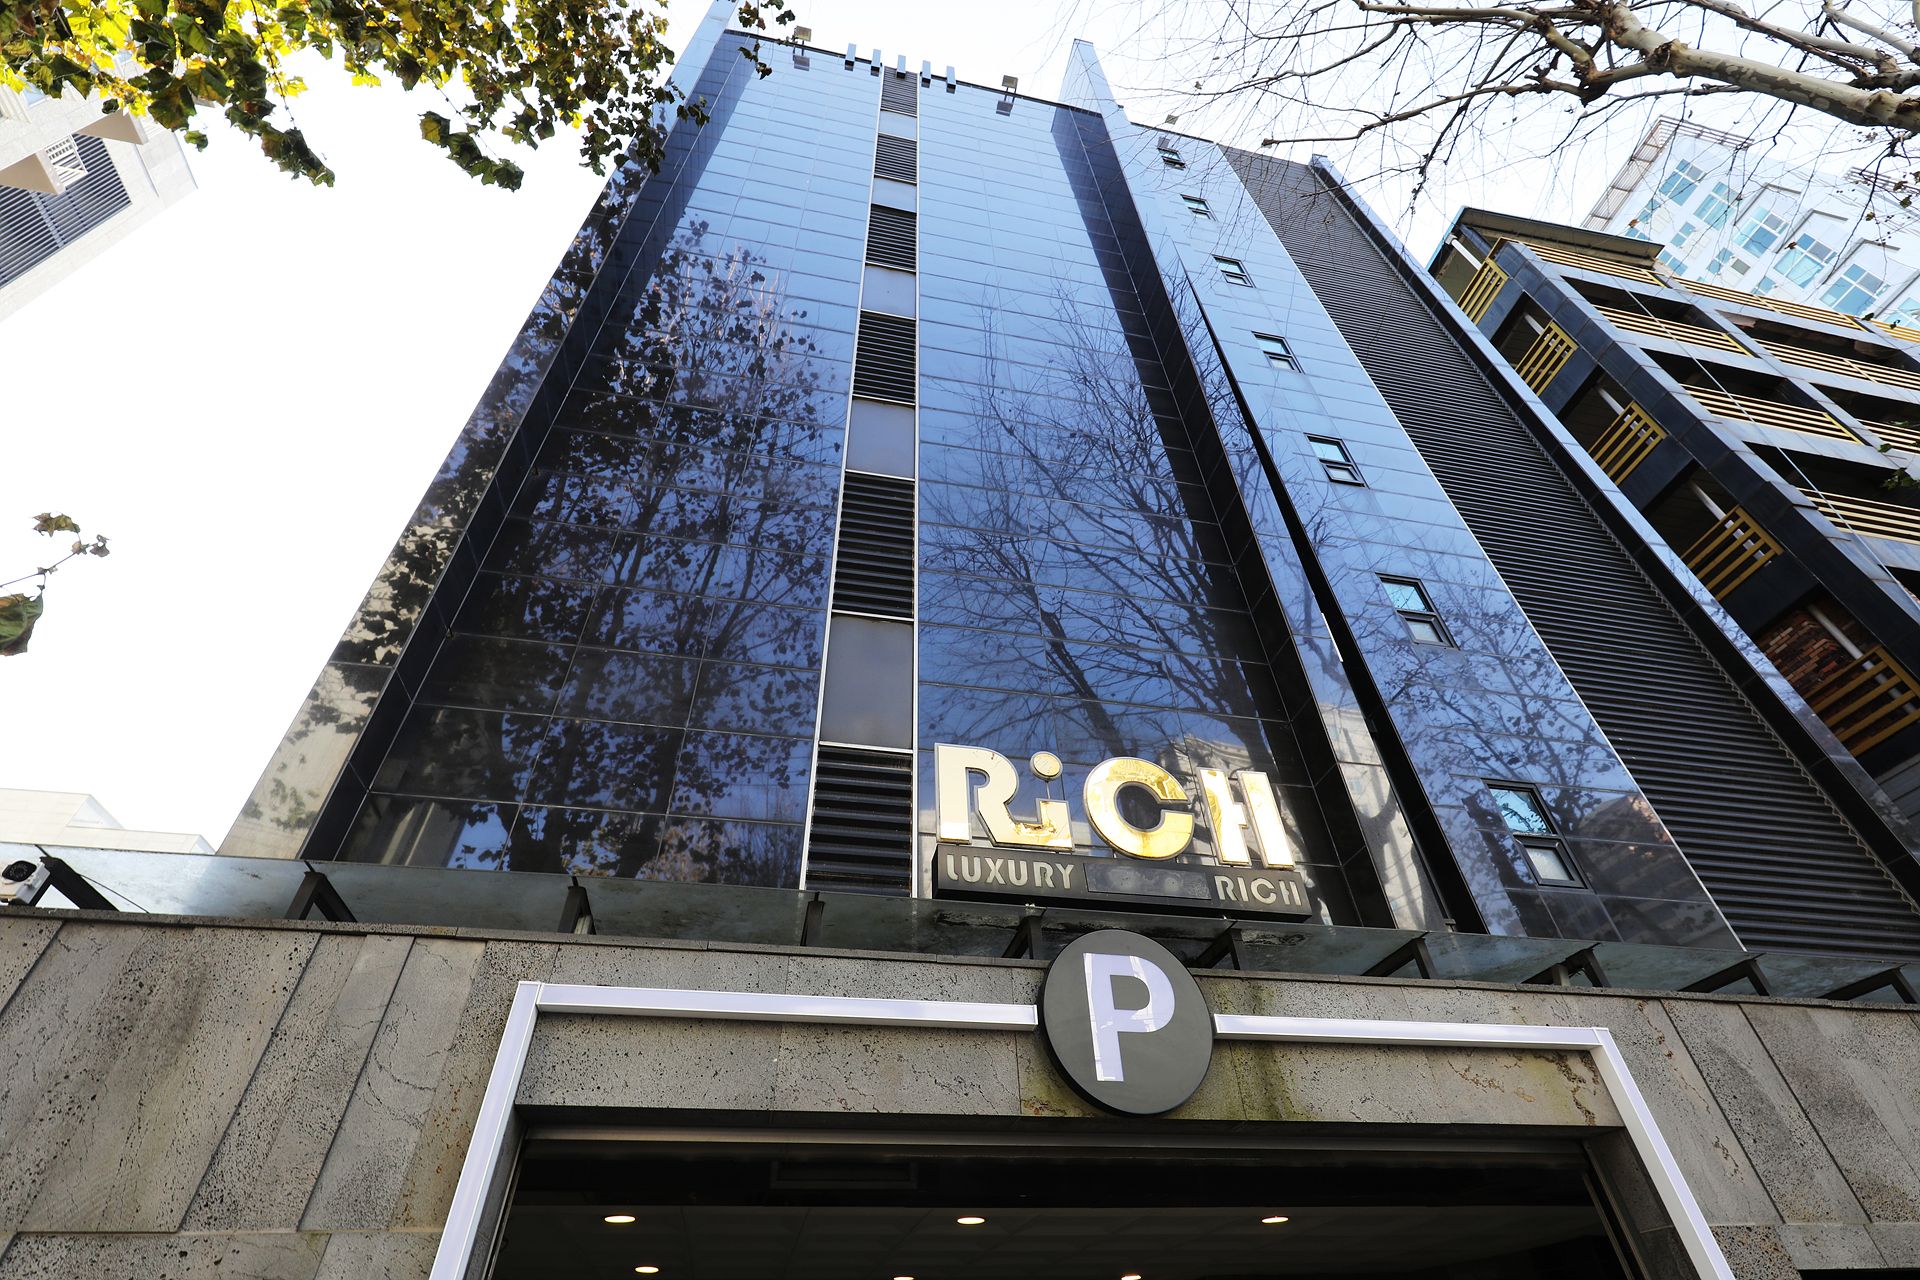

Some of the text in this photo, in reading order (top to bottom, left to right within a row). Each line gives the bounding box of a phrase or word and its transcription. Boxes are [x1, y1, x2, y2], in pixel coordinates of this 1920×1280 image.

[946, 853, 1302, 906] LUXURY RICH
[1083, 952, 1175, 1082] P
